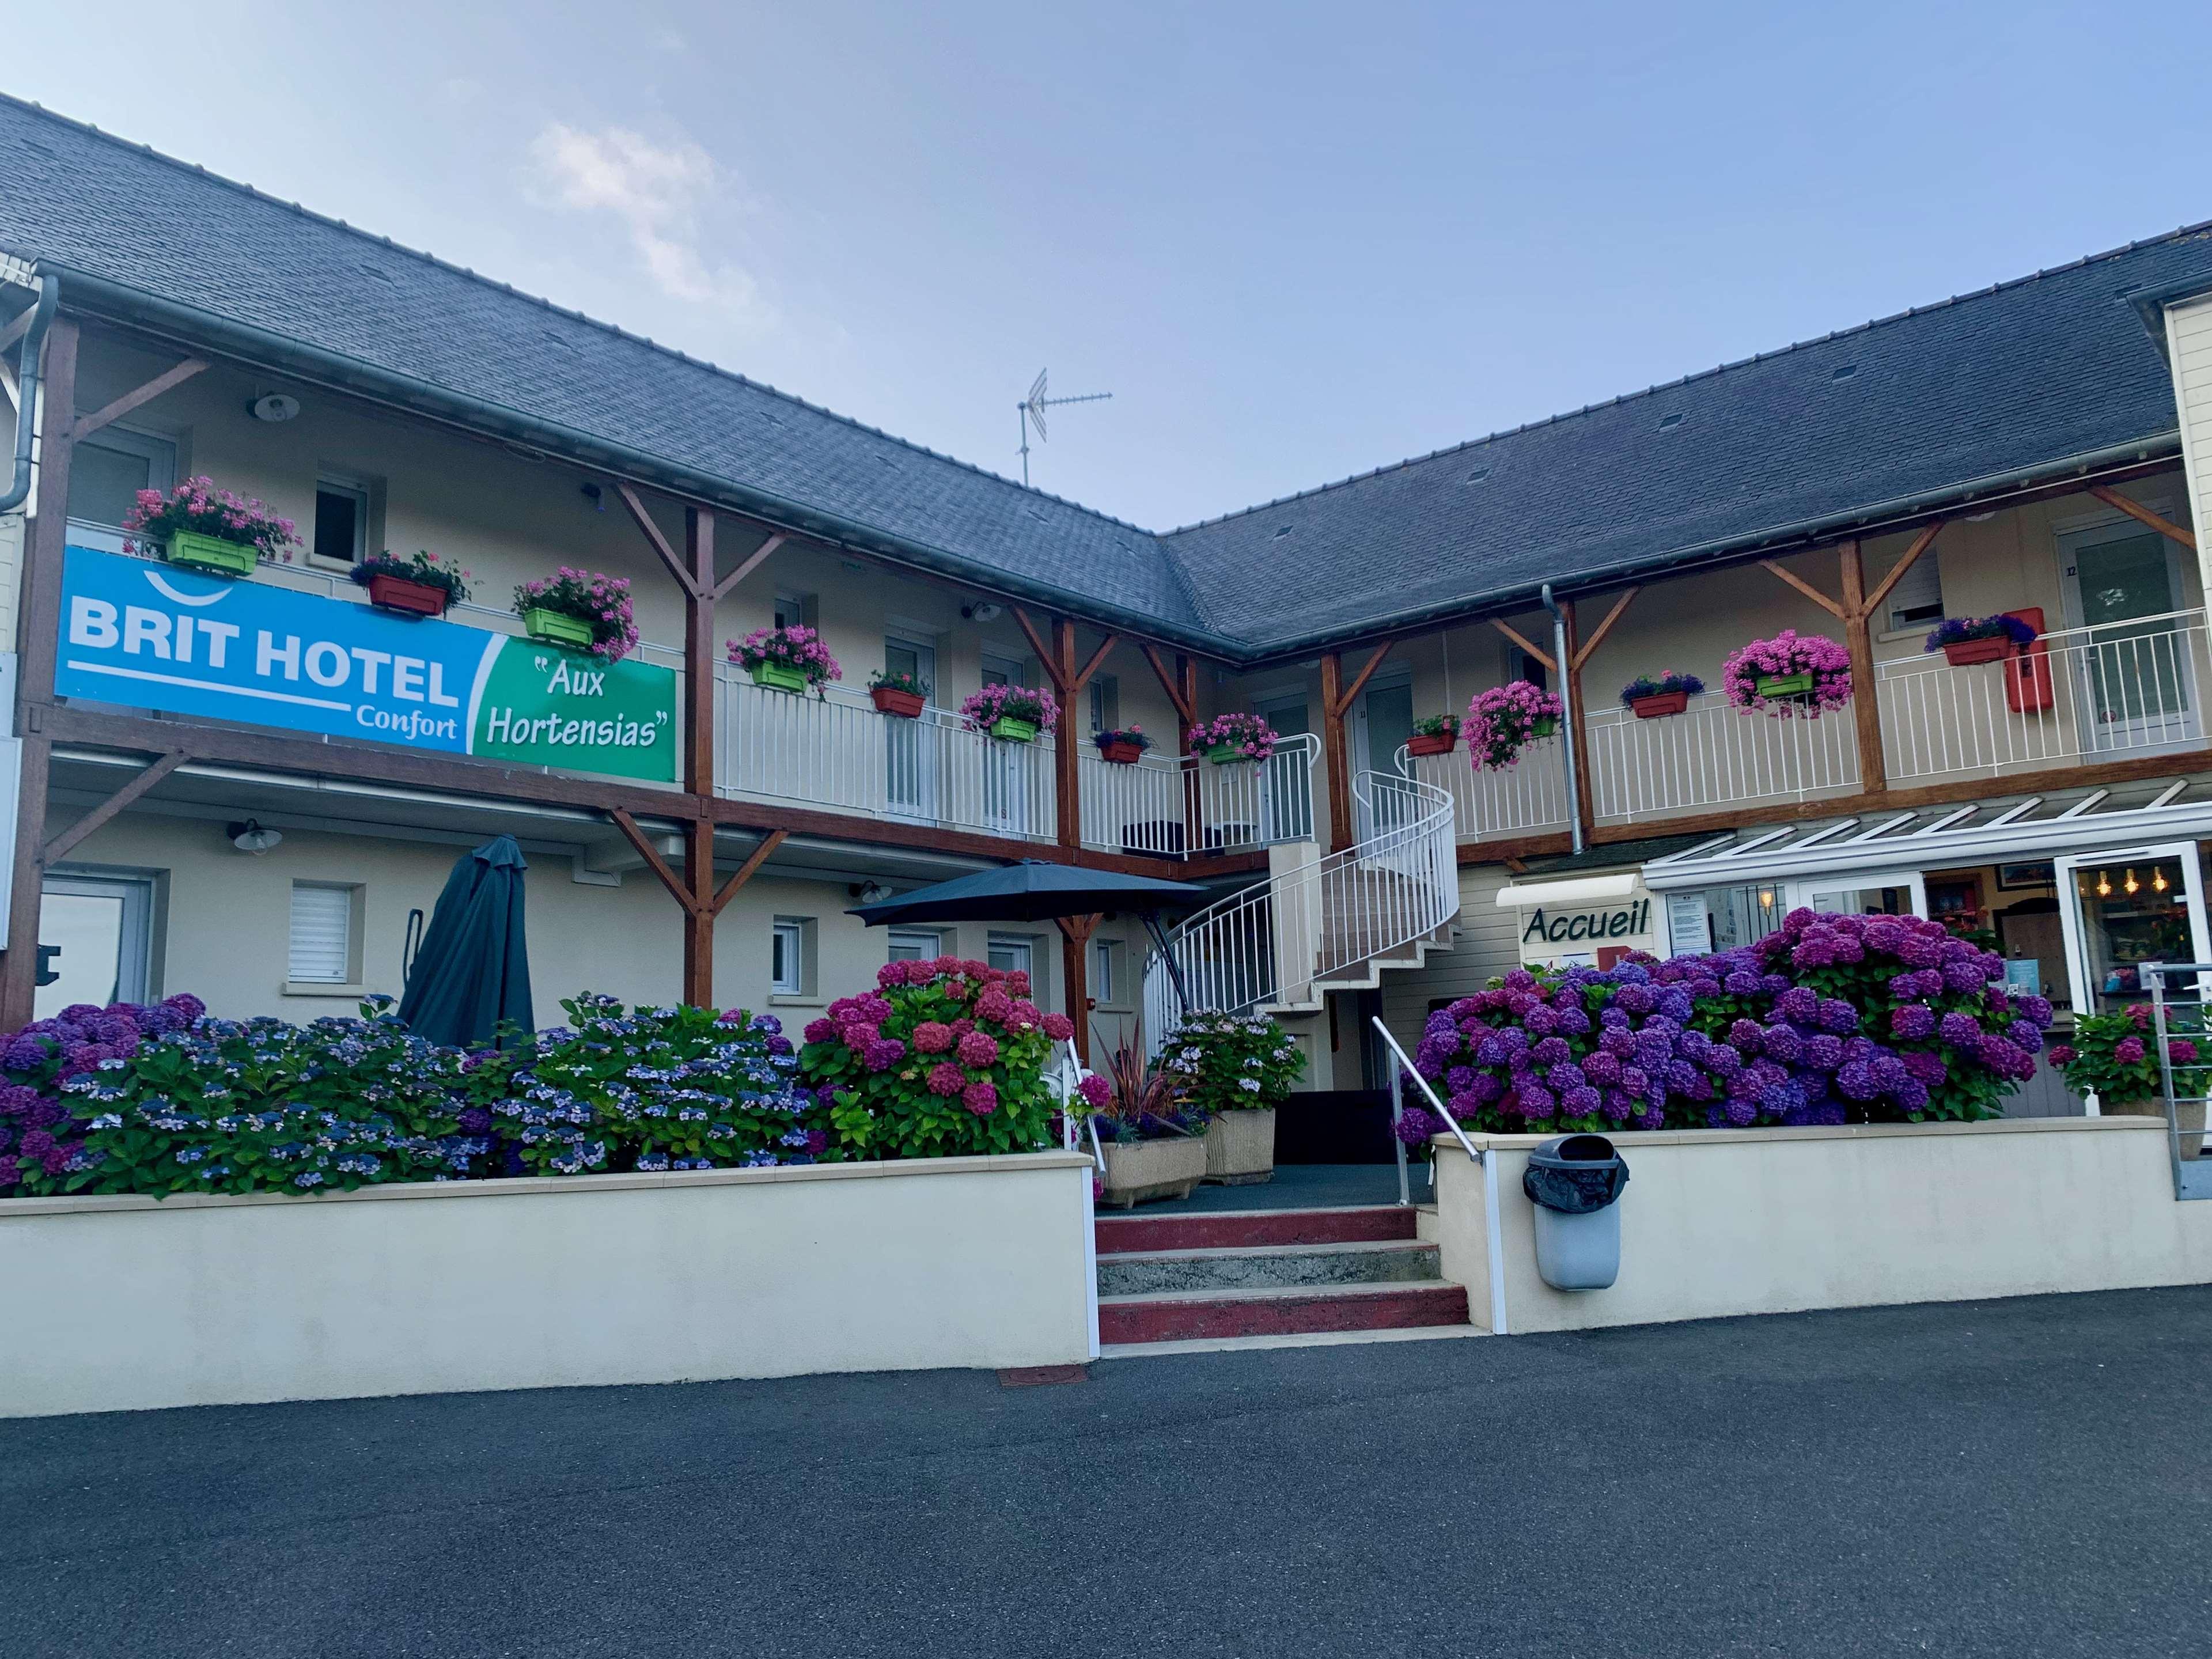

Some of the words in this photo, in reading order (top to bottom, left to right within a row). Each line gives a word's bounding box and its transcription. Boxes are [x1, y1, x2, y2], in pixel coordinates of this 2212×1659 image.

[70, 596, 240, 668] BRIT
[256, 630, 459, 708] HOTEL
[357, 704, 457, 740] Confort
[1522, 897, 1649, 943] Accueil
